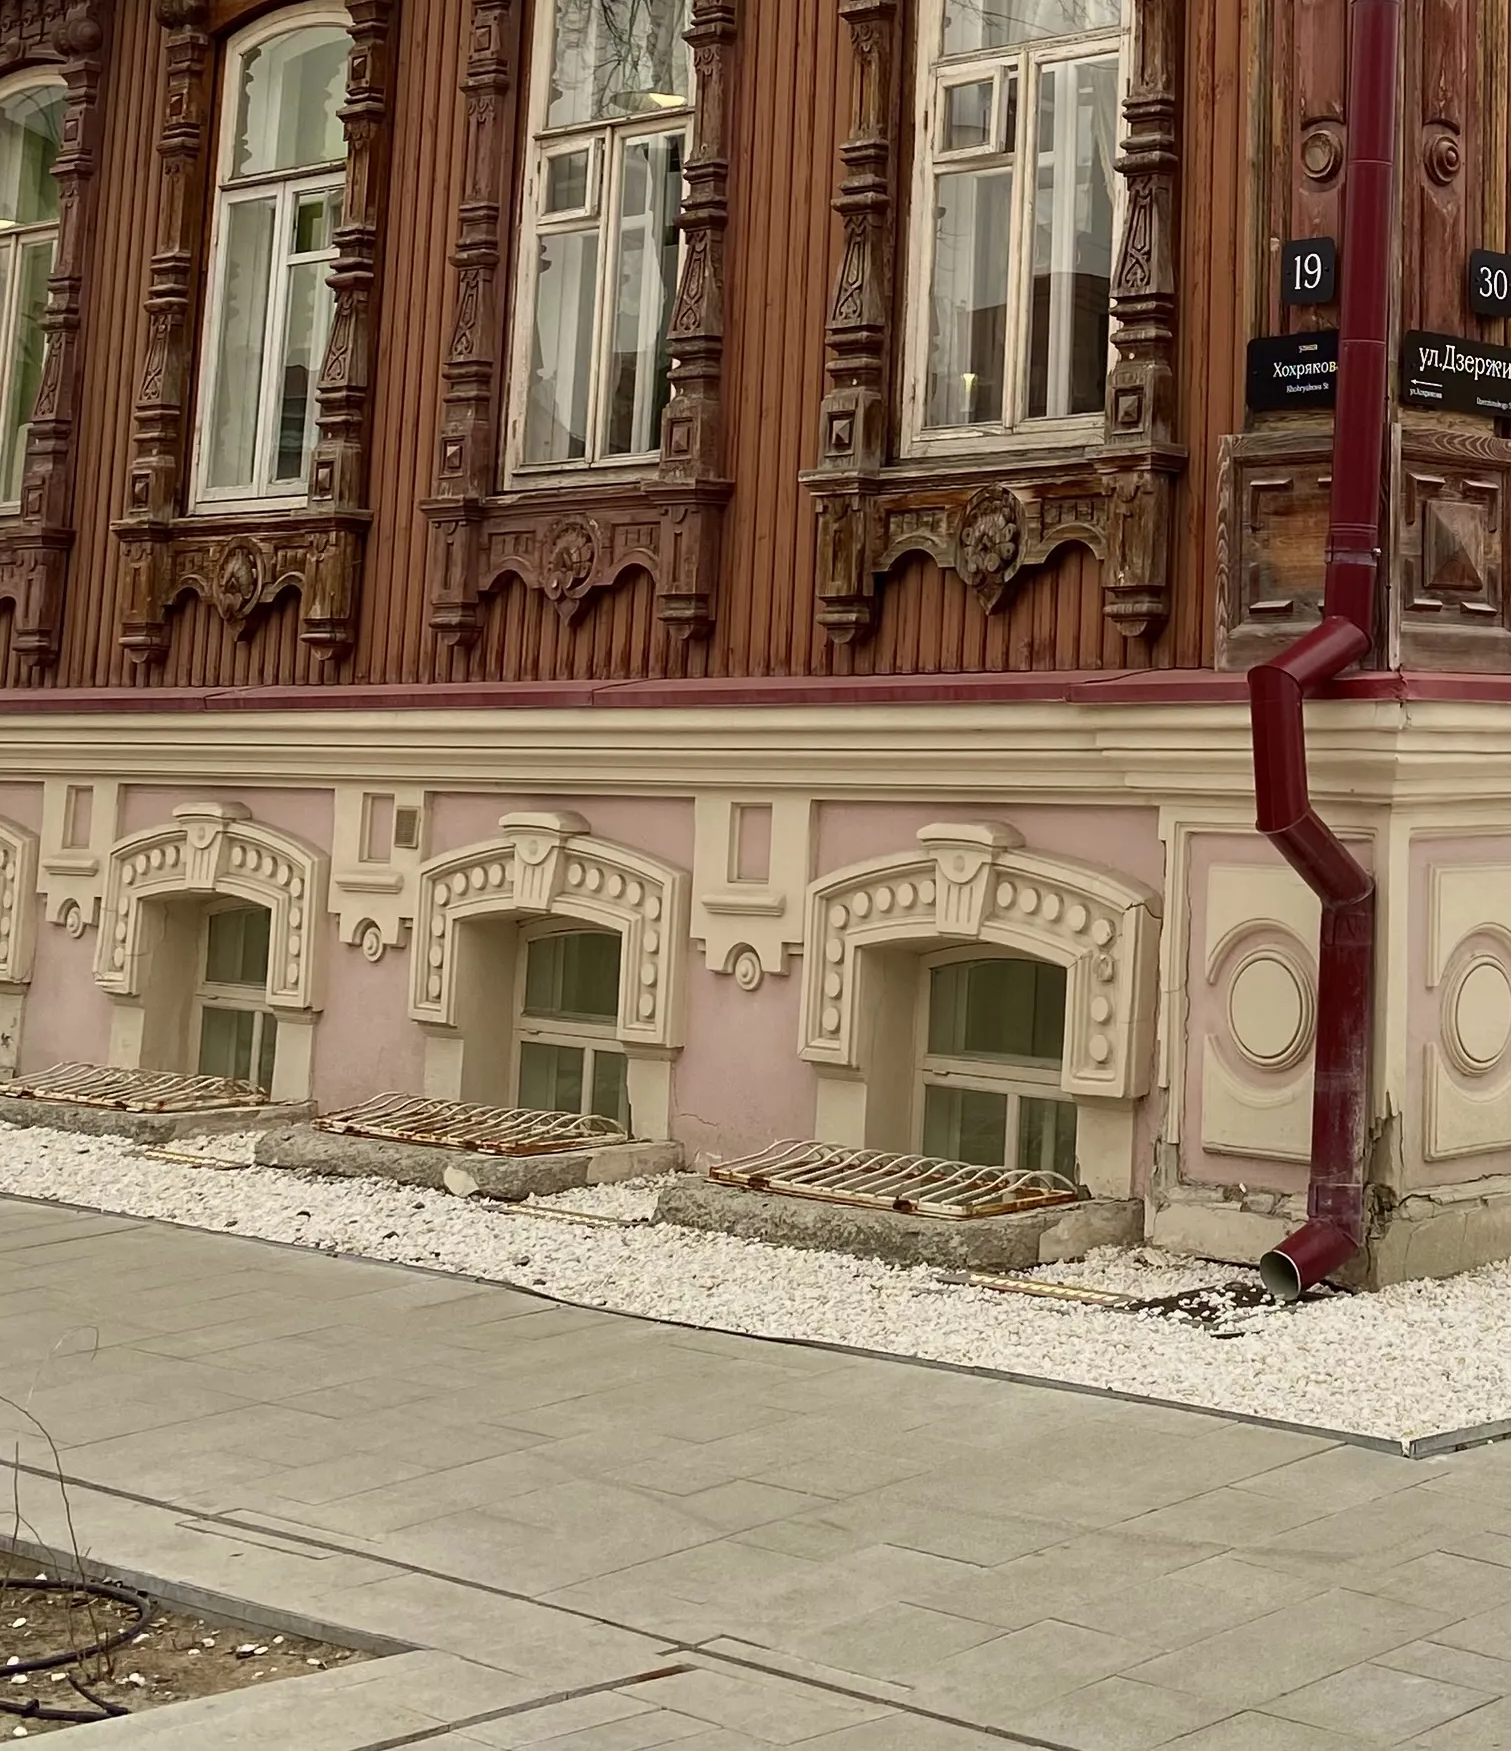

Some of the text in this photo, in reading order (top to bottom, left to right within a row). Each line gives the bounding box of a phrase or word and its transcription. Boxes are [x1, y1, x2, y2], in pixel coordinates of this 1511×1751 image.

[1294, 253, 1322, 290] 19
[1479, 266, 1508, 300] 30
[1272, 360, 1339, 380] Хохряков
